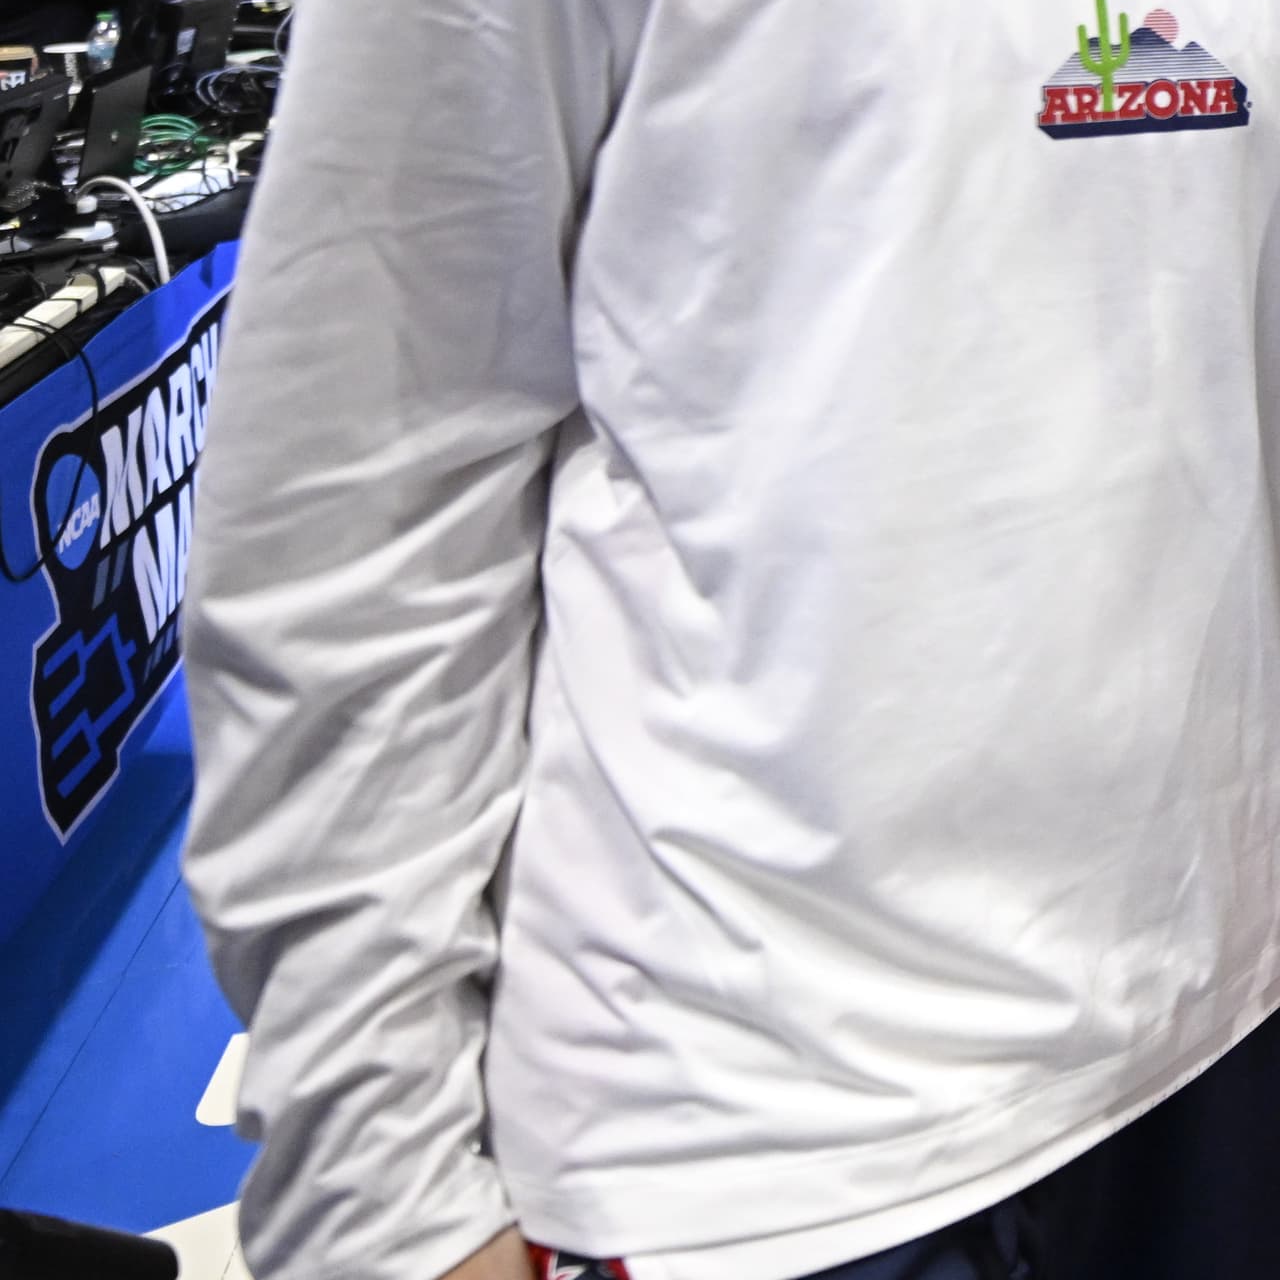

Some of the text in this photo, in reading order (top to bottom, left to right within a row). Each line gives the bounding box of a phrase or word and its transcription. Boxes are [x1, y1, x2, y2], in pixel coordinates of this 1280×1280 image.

[1038, 77, 1238, 126] ARIZONA
[100, 322, 218, 551] MARCH
[57, 491, 100, 557] NCAA
